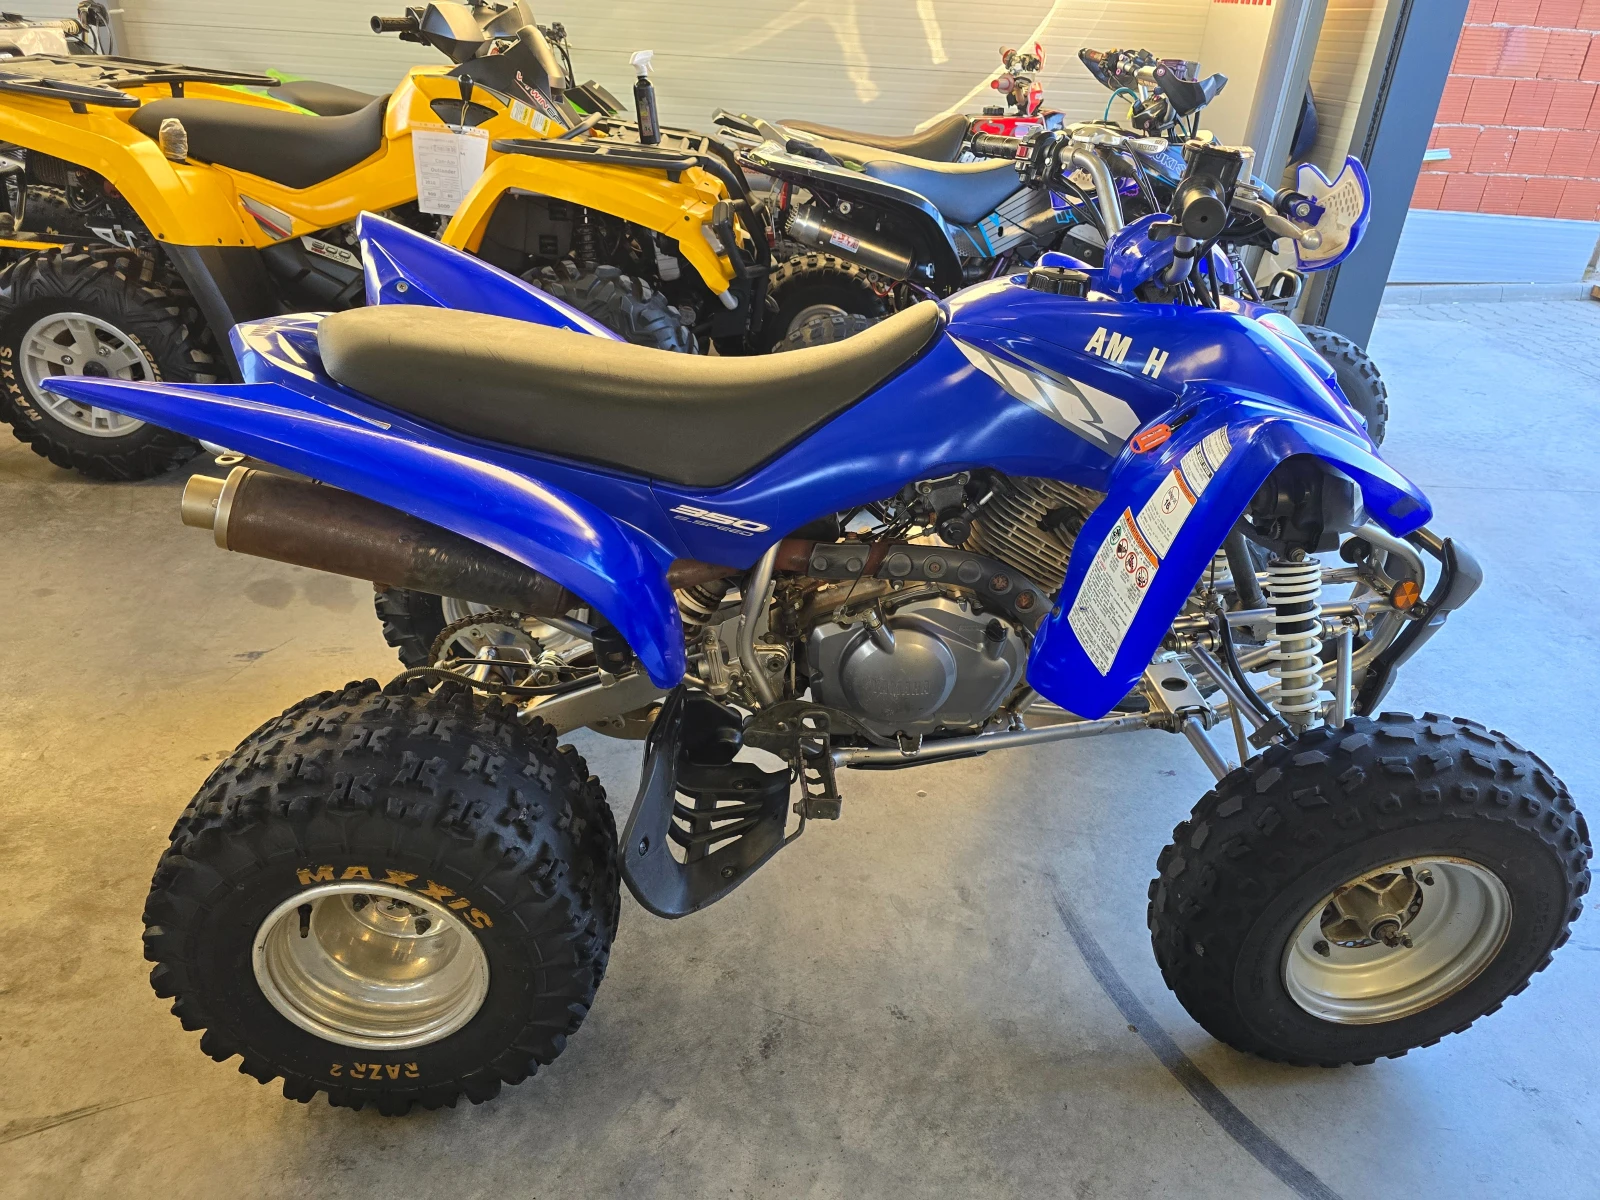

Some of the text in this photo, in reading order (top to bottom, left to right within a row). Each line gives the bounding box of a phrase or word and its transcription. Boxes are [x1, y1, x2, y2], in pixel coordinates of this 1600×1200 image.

[430, 167, 456, 175] Outlander
[0, 346, 43, 422] MAXXIS
[669, 504, 771, 533] 350
[296, 864, 494, 929] MAXXIS
[329, 1062, 420, 1080] RAZR 2
